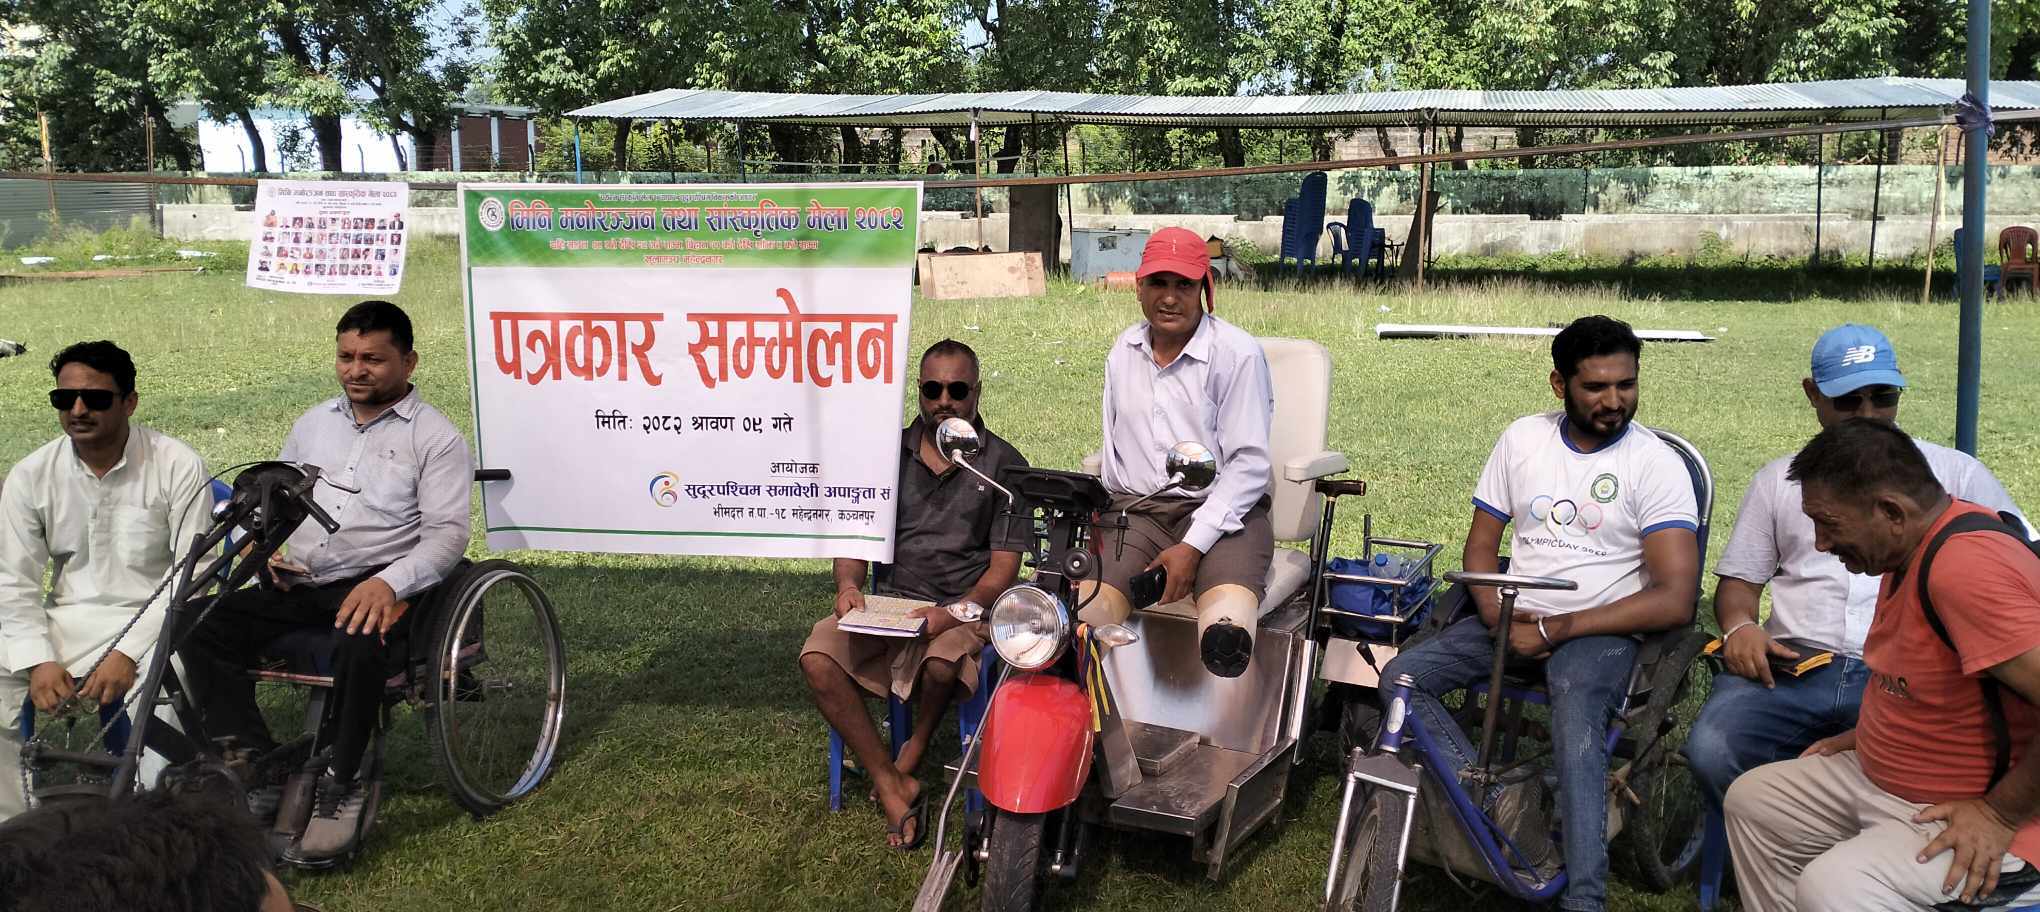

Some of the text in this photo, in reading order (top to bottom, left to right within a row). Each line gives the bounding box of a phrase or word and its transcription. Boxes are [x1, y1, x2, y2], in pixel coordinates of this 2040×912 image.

[508, 199, 904, 238] मिनि मनोरञ्जन तथा सांस्कृतिक मेला २०८२
[489, 287, 898, 388] पत्रकार सम्मेलन
[642, 415, 682, 434] २०८२
[692, 415, 735, 432] श्रावण
[742, 416, 763, 433] ०९
[771, 412, 794, 432] गते
[770, 459, 820, 475] आयोजक
[684, 481, 761, 500] सुदूरपश्चिम
[766, 482, 819, 498] समावेशी
[824, 485, 876, 504] अपाङ्गता
[713, 504, 743, 520] भीमदत्त
